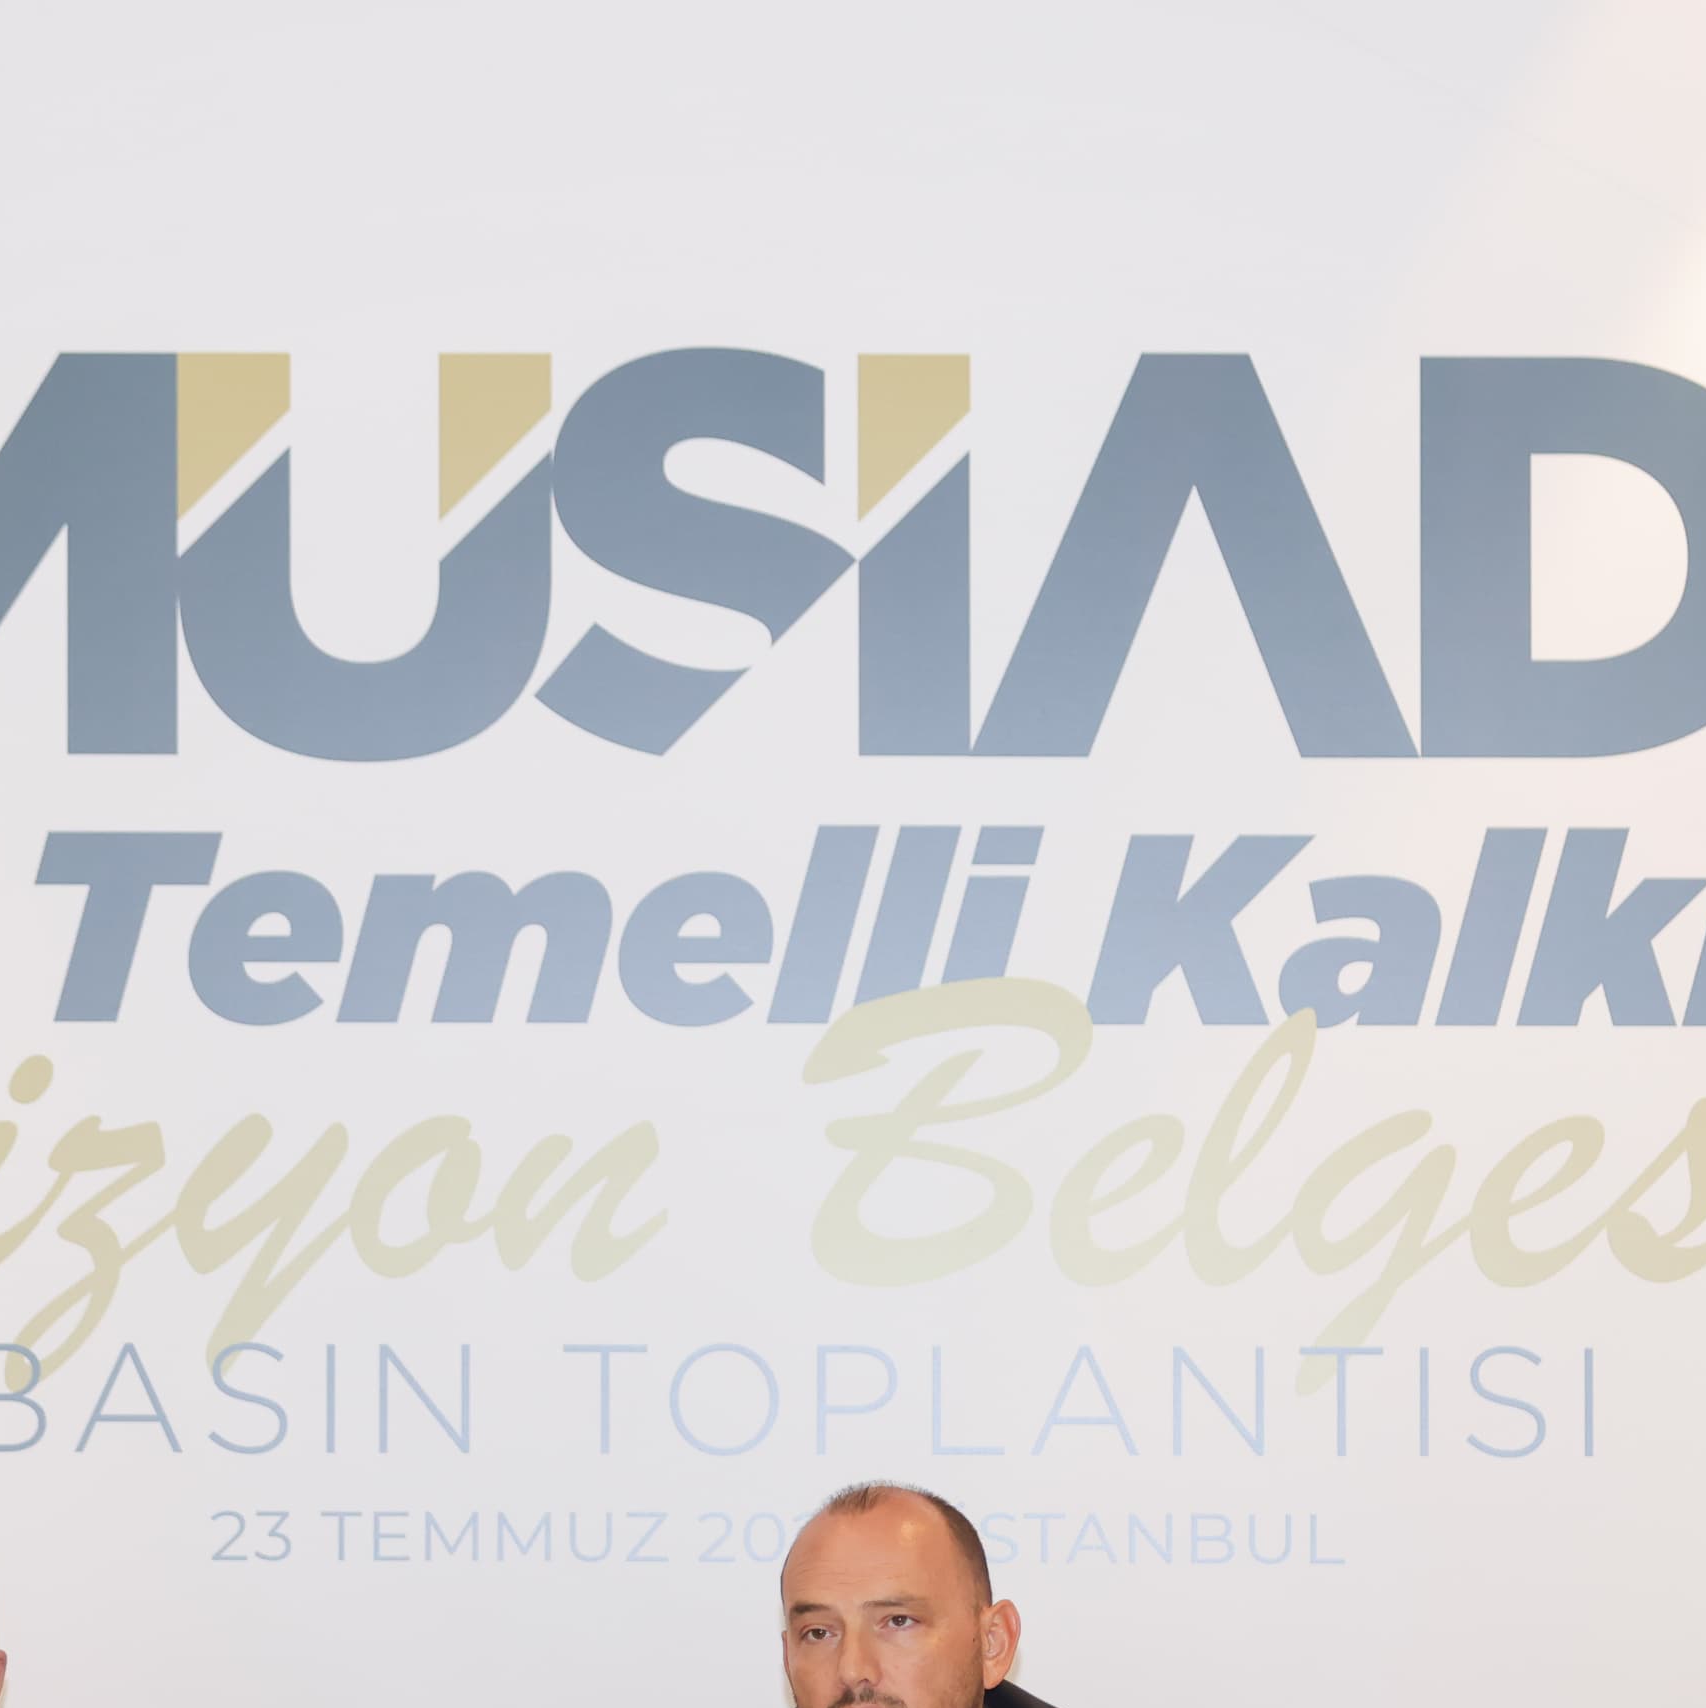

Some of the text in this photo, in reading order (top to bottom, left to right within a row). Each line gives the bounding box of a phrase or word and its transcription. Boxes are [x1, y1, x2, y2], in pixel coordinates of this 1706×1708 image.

[35, 826, 1044, 1026] Temelli
[563, 1343, 1594, 1458] TOPLANTISI
[210, 1509, 293, 1562] 23
[321, 1510, 671, 1563] TEMMUZ
